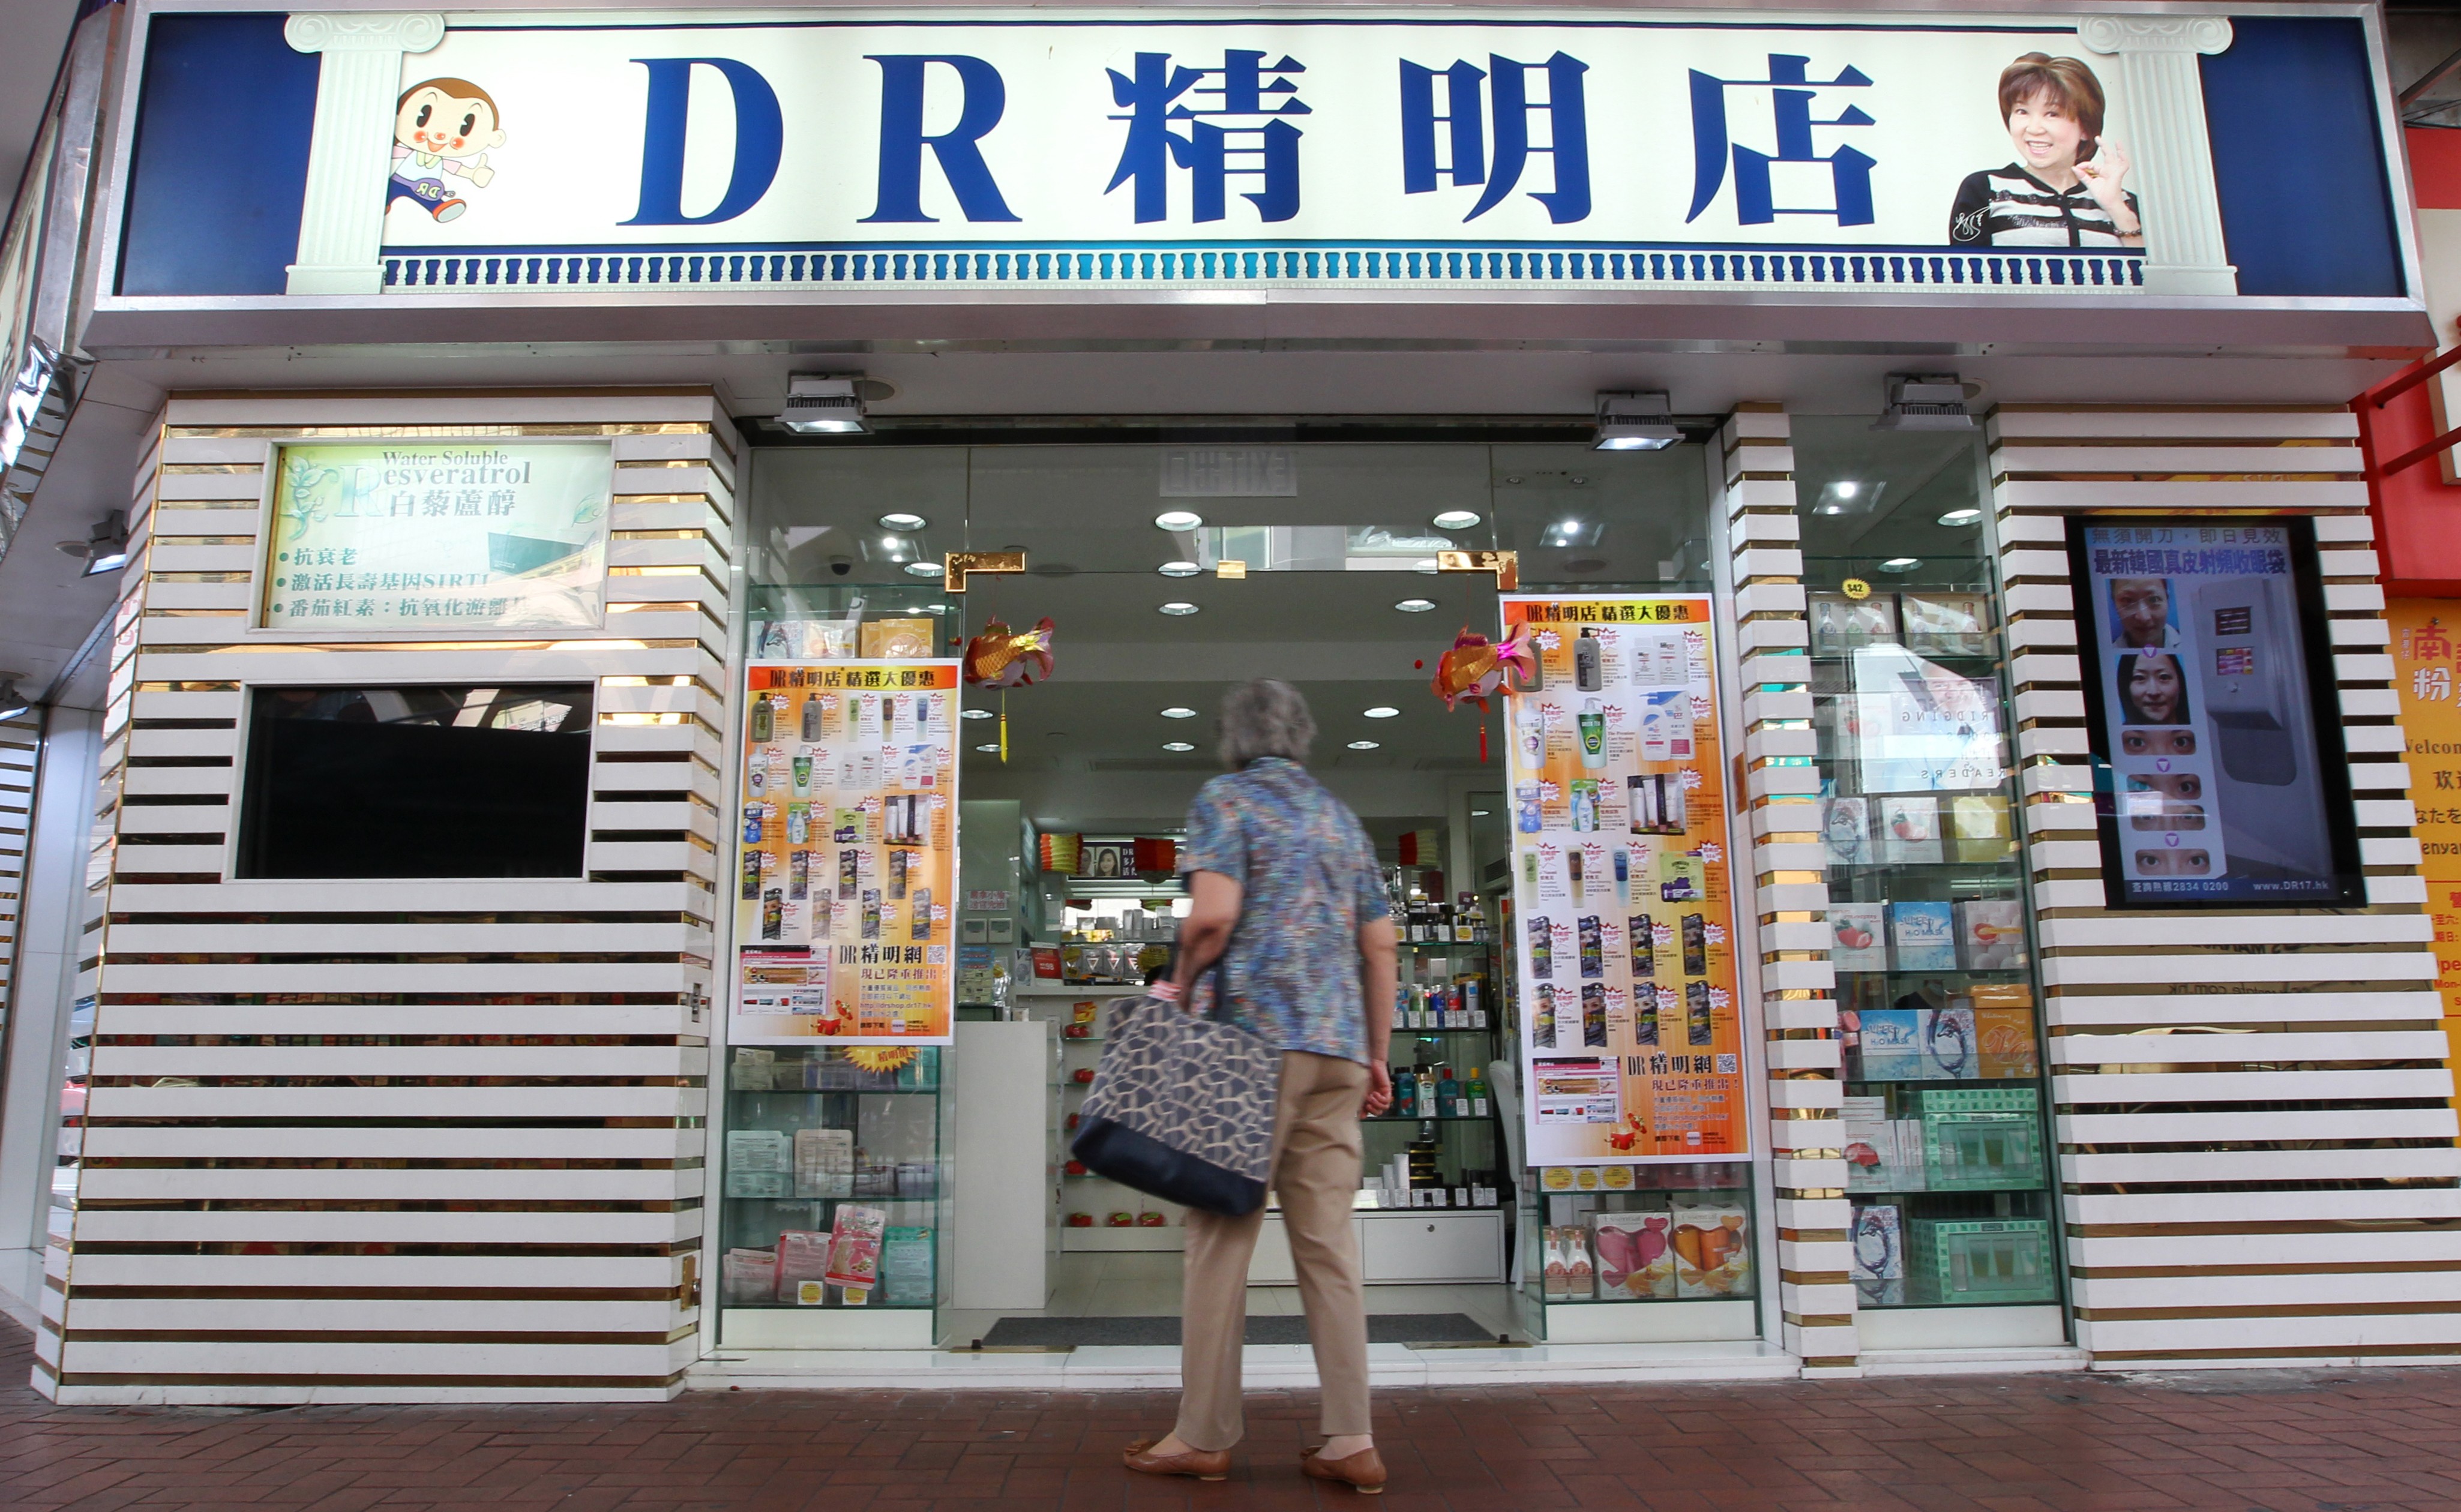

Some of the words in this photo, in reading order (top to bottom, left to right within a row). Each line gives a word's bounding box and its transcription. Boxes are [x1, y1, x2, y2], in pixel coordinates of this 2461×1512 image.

[382, 451, 437, 466] Water
[442, 451, 508, 466] Soluble
[389, 489, 515, 518] 白藜蘆醇
[294, 548, 358, 566] 抗衰老
[2094, 549, 2286, 575] 最新韓國真皮射頻收眼袋
[1602, 605, 1689, 622] 精選大優惠
[846, 670, 935, 687] 精選大優惠
[2203, 882, 2228, 891] 0200
[2253, 880, 2329, 890] www.DR17.hk
[2432, 913, 2459, 926] 至六:
[2434, 980, 2461, 989] Mon-
